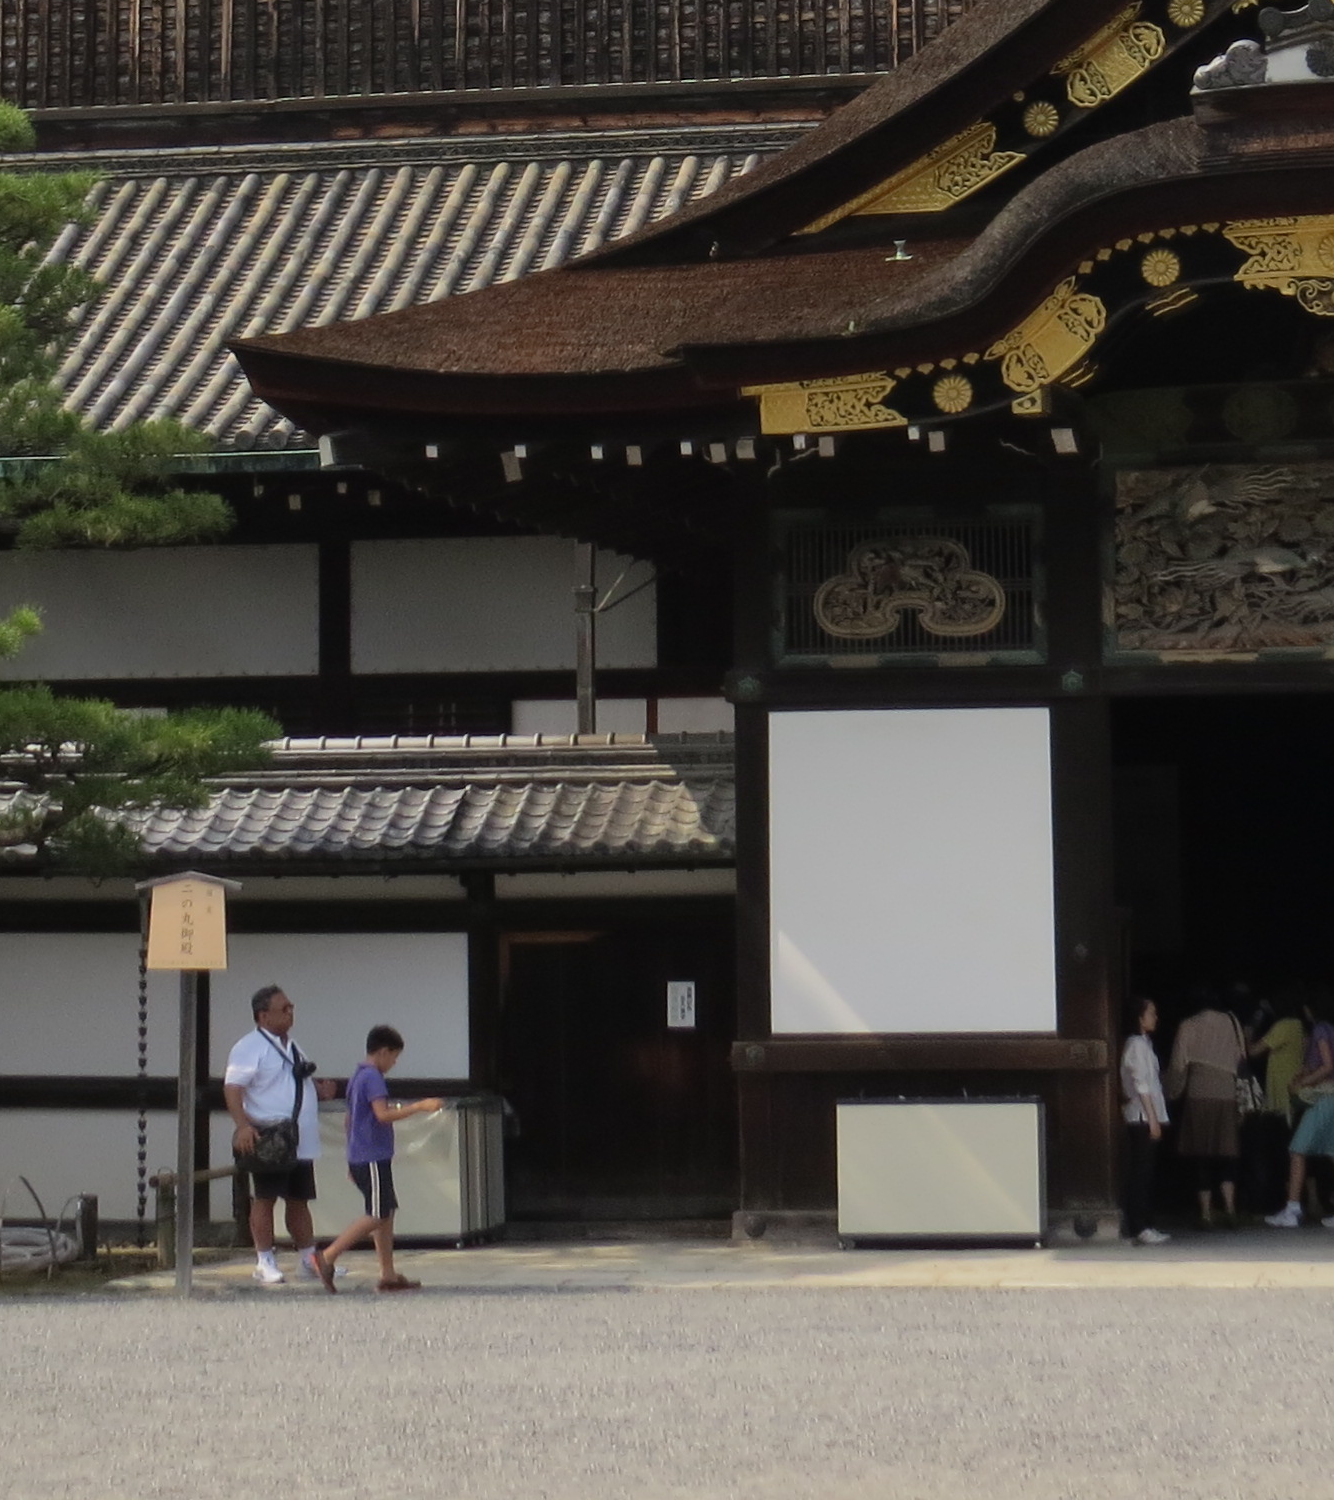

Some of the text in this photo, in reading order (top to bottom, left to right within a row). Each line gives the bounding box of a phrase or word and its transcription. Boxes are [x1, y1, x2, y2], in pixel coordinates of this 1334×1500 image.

[181, 884, 194, 956] 二の丸御殿
